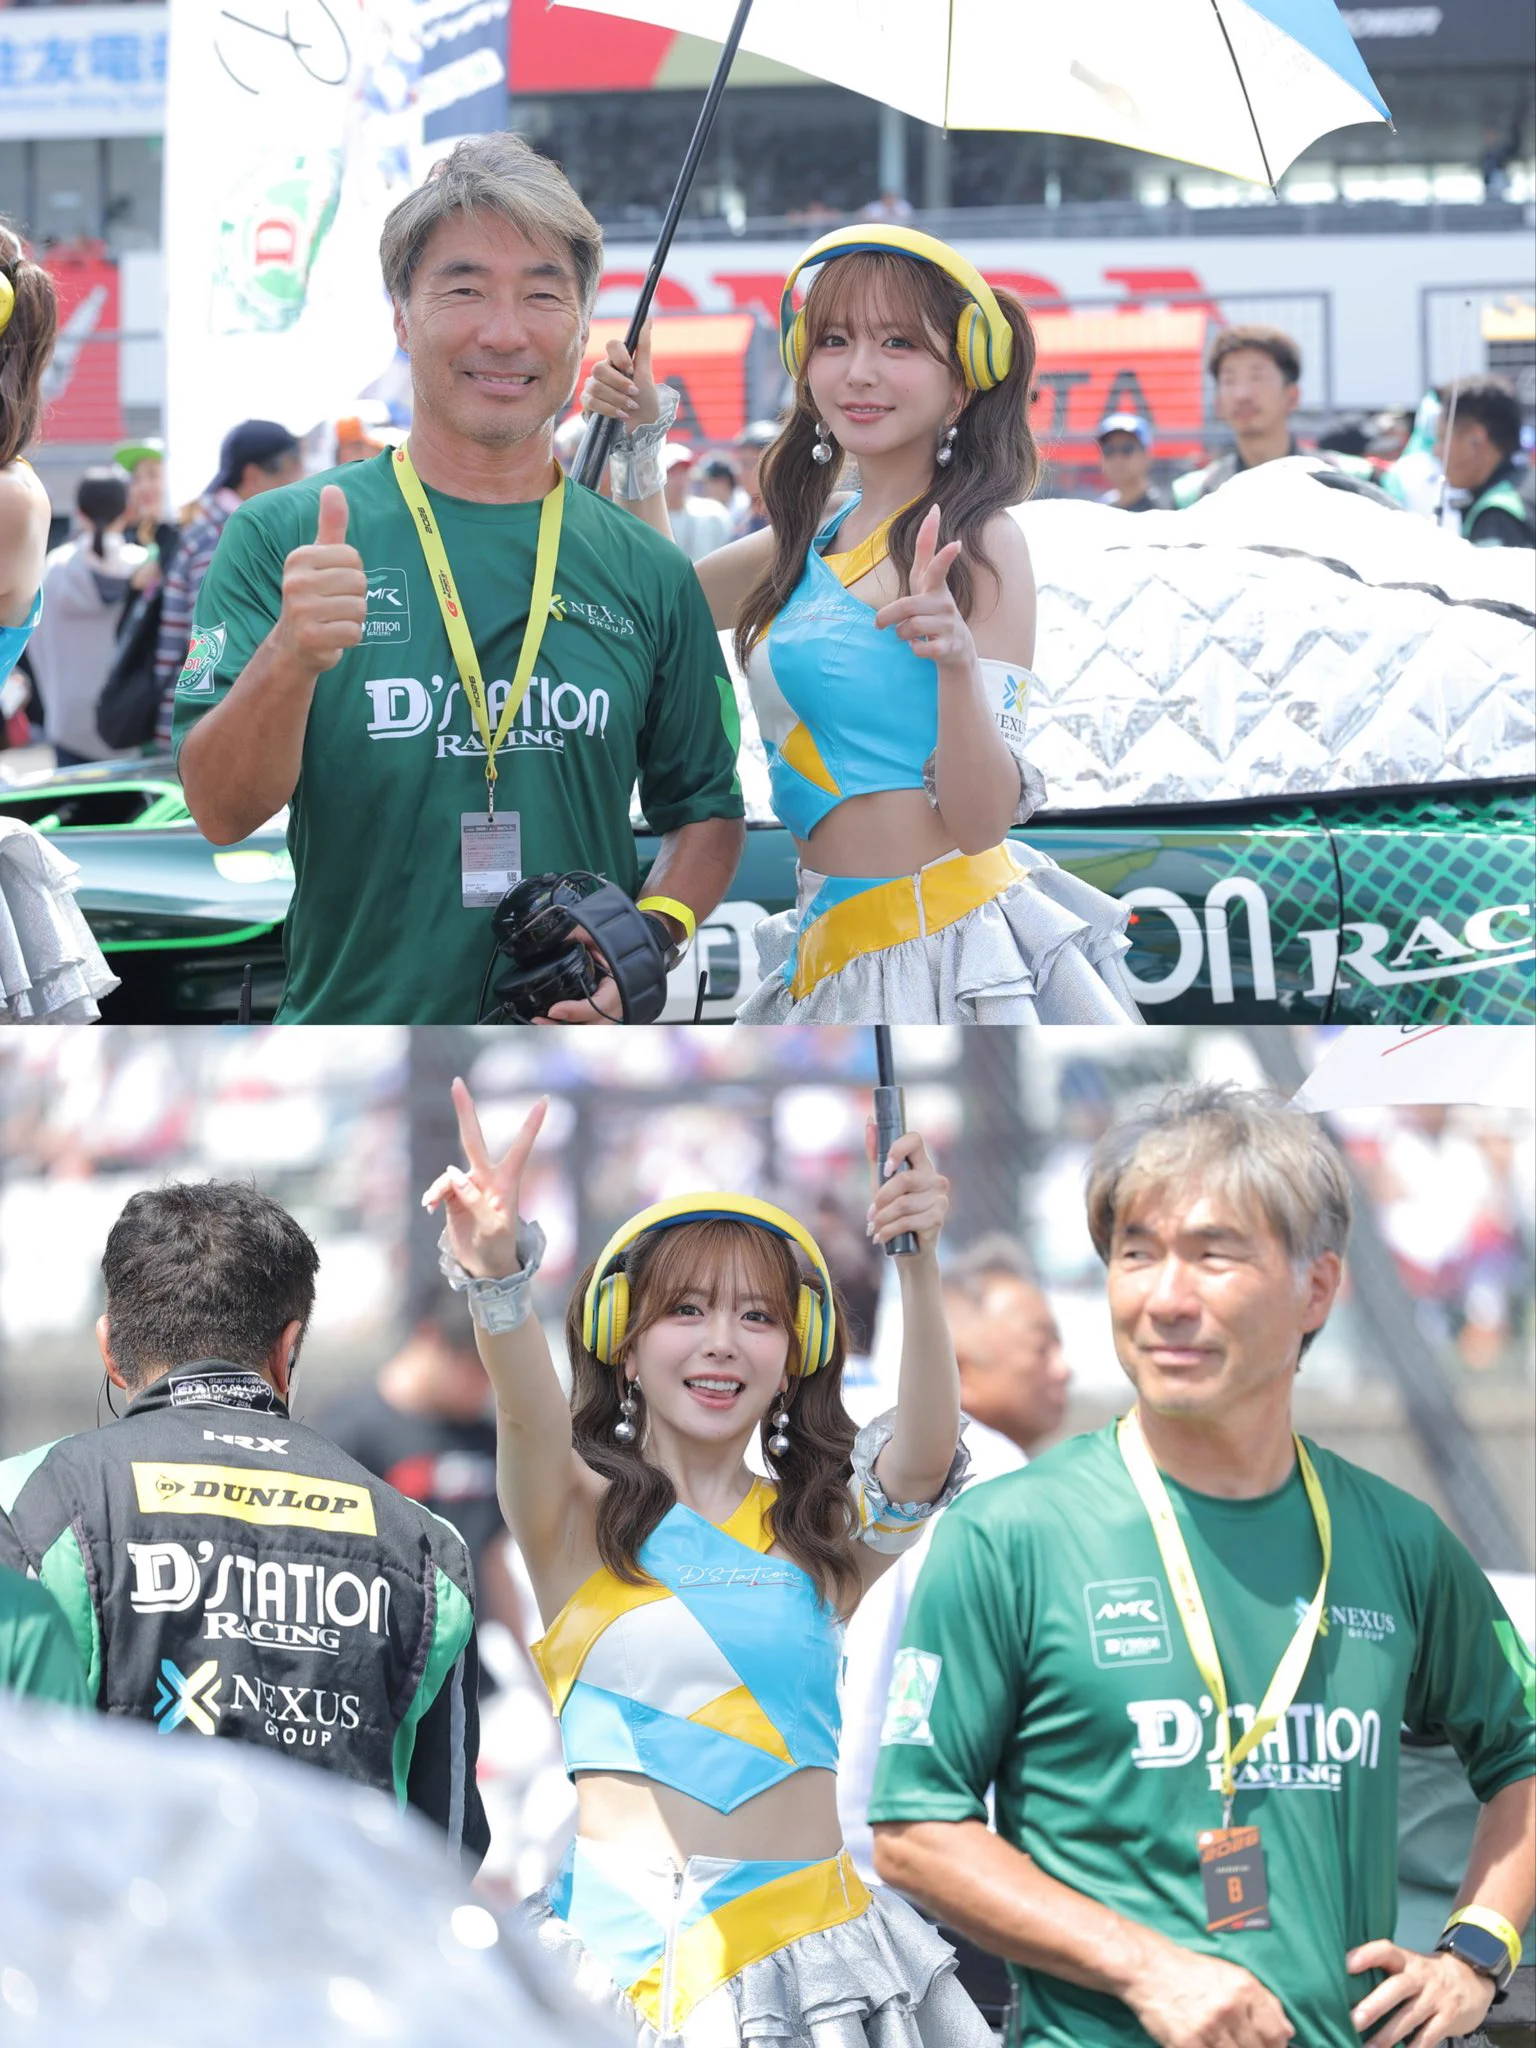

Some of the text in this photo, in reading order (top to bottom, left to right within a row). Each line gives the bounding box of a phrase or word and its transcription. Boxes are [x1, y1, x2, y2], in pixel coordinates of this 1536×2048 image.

[365, 587, 404, 607] MR
[203, 1429, 290, 1455] HRX
[190, 1480, 358, 1514] DUNLOP
[127, 1540, 391, 1637] D'STATION
[203, 1612, 341, 1656] RACING
[1330, 1604, 1396, 1635] NEXUS
[230, 1674, 361, 1730] NEXUS
[264, 1719, 333, 1748] GROUP
